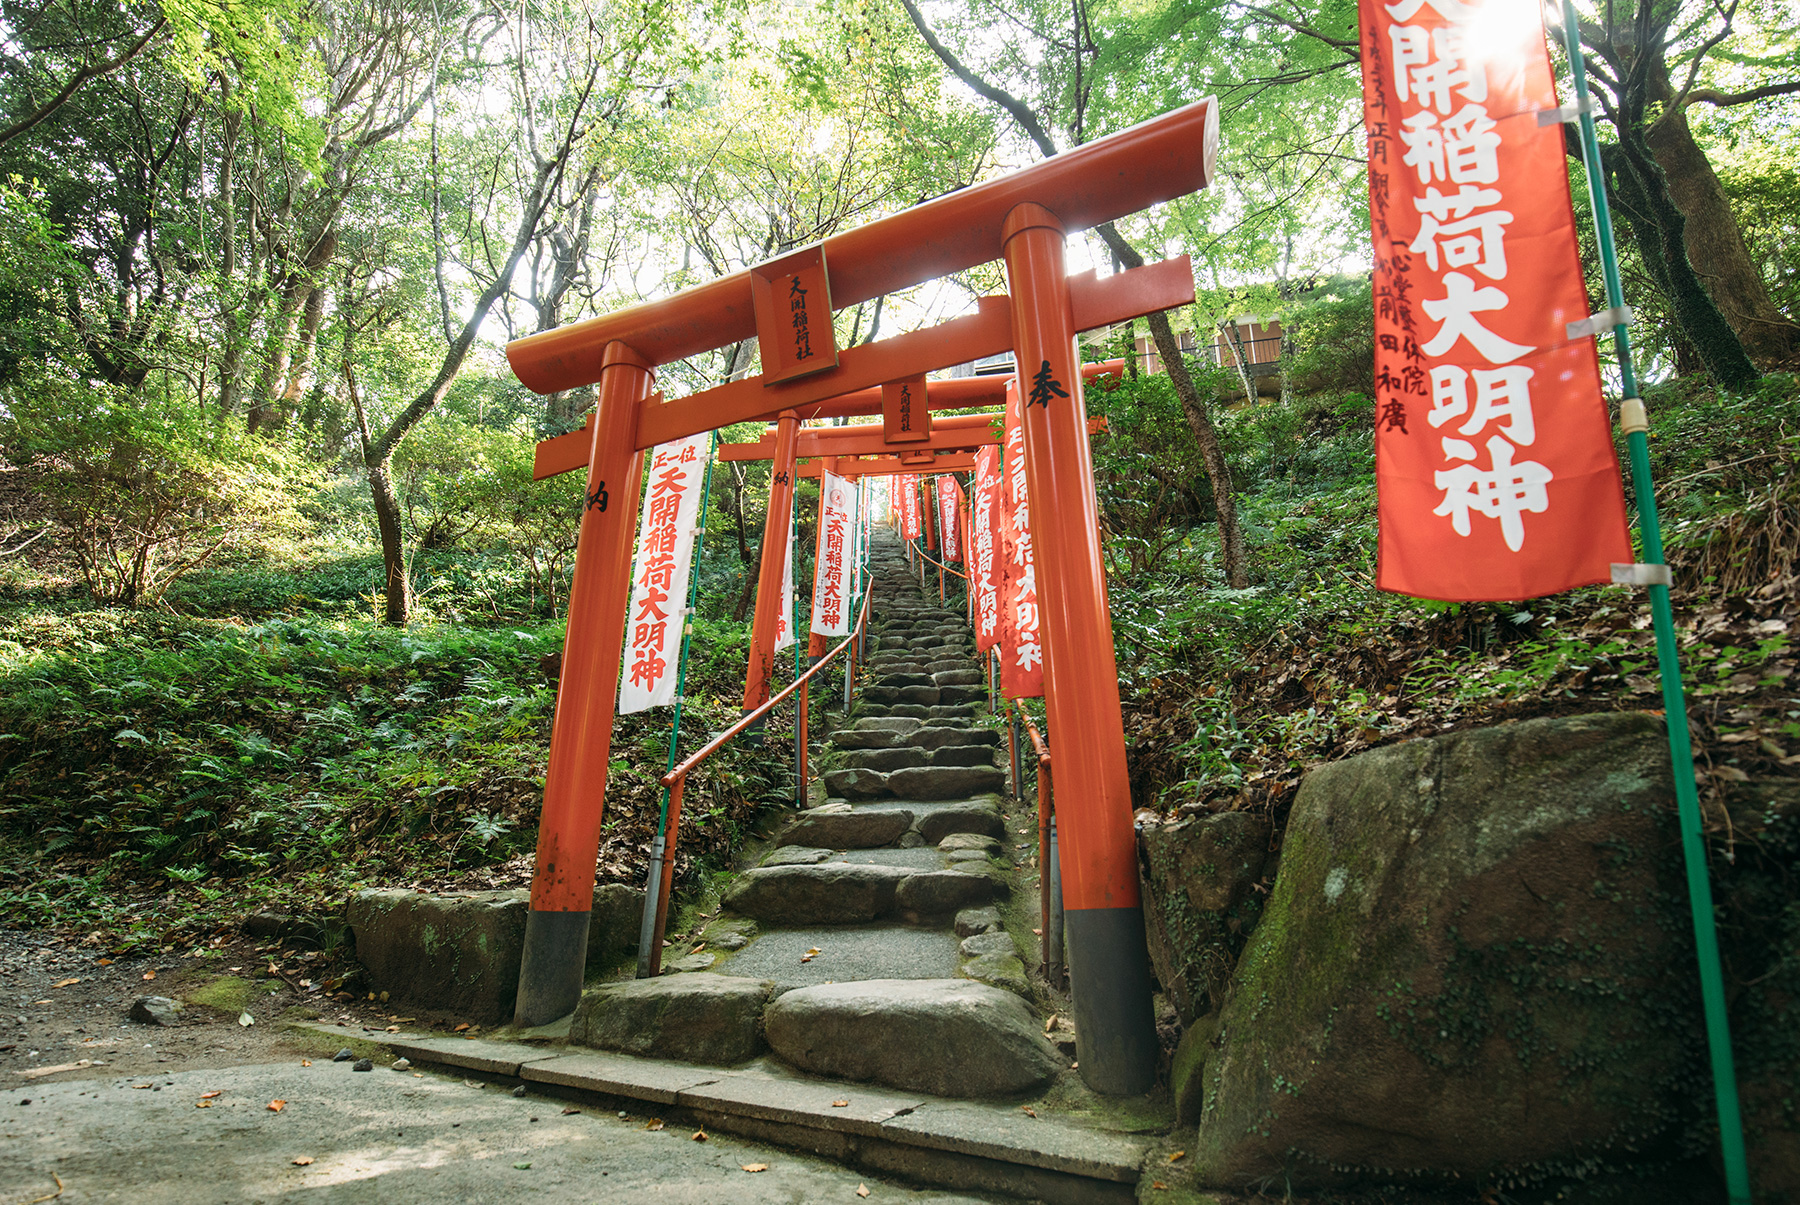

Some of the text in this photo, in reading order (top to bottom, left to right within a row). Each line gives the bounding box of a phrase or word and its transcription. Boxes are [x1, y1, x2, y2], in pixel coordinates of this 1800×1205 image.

[789, 275, 814, 361] 天開稲荷社
[1026, 360, 1070, 409] 奉
[652, 443, 698, 472] 正一位
[824, 505, 849, 524] 正一位
[629, 465, 688, 693] 天開稲荷大明神
[820, 519, 845, 631] 天開稲荷大明神
[975, 491, 997, 637] 天開稲荷大明神
